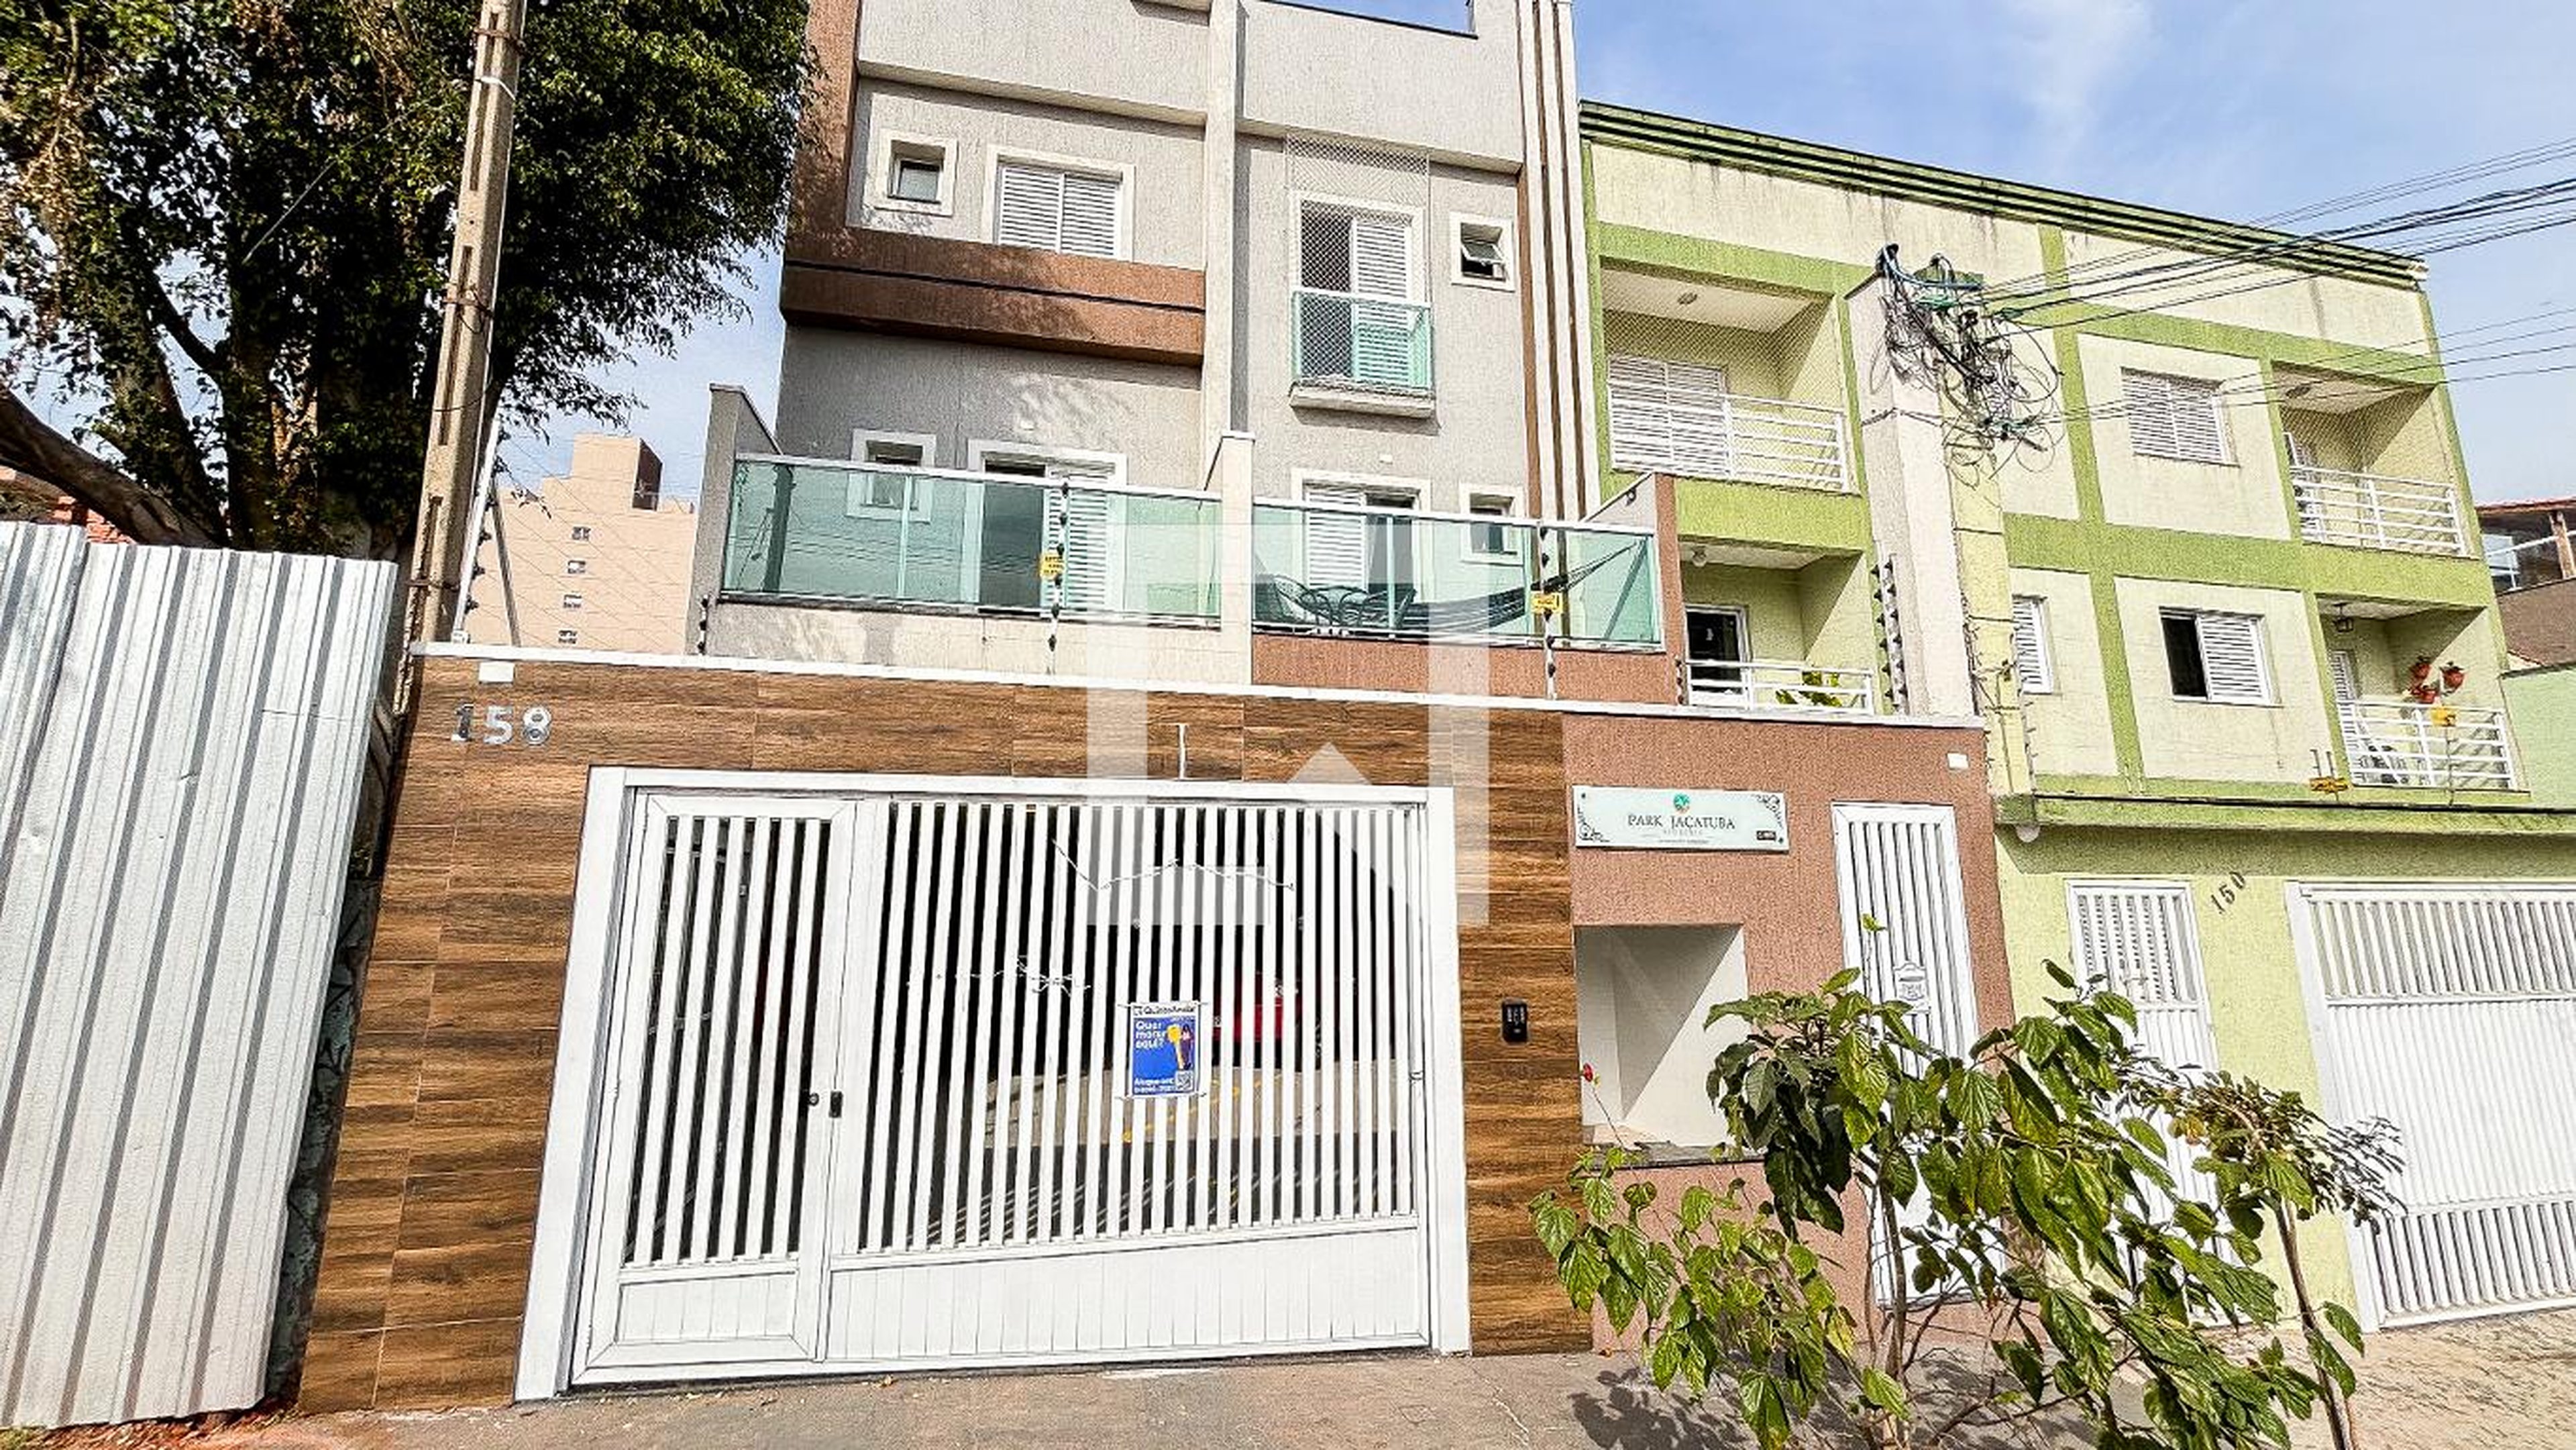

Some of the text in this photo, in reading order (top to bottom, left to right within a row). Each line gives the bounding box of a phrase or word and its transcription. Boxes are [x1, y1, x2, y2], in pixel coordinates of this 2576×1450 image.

[451, 703, 552, 745] 158
[1627, 815, 1663, 827] PARK
[2210, 872, 2246, 915] 150
[1135, 1021, 1162, 1030] Quer
[1135, 1031, 1167, 1039] morar
[1135, 1039, 1165, 1049] aqui?
